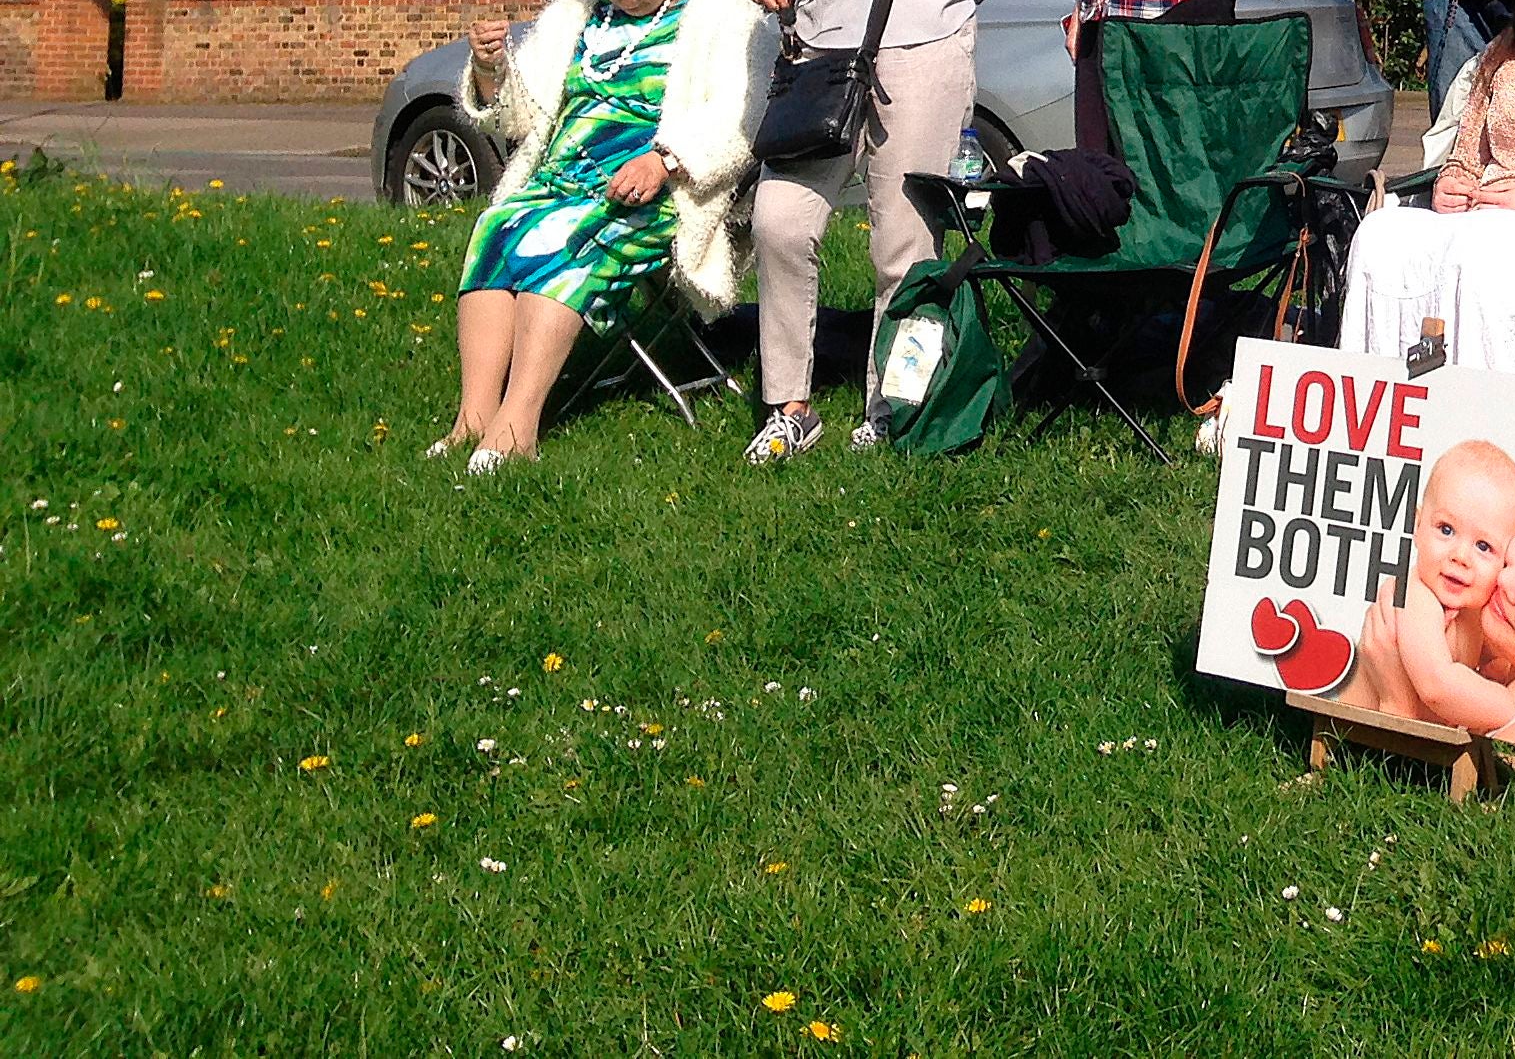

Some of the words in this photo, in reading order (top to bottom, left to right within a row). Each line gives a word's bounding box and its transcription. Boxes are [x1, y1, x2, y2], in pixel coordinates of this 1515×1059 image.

[1252, 364, 1429, 461] LOVE
[1237, 436, 1422, 535] THEM
[1234, 508, 1413, 609] BOTH
